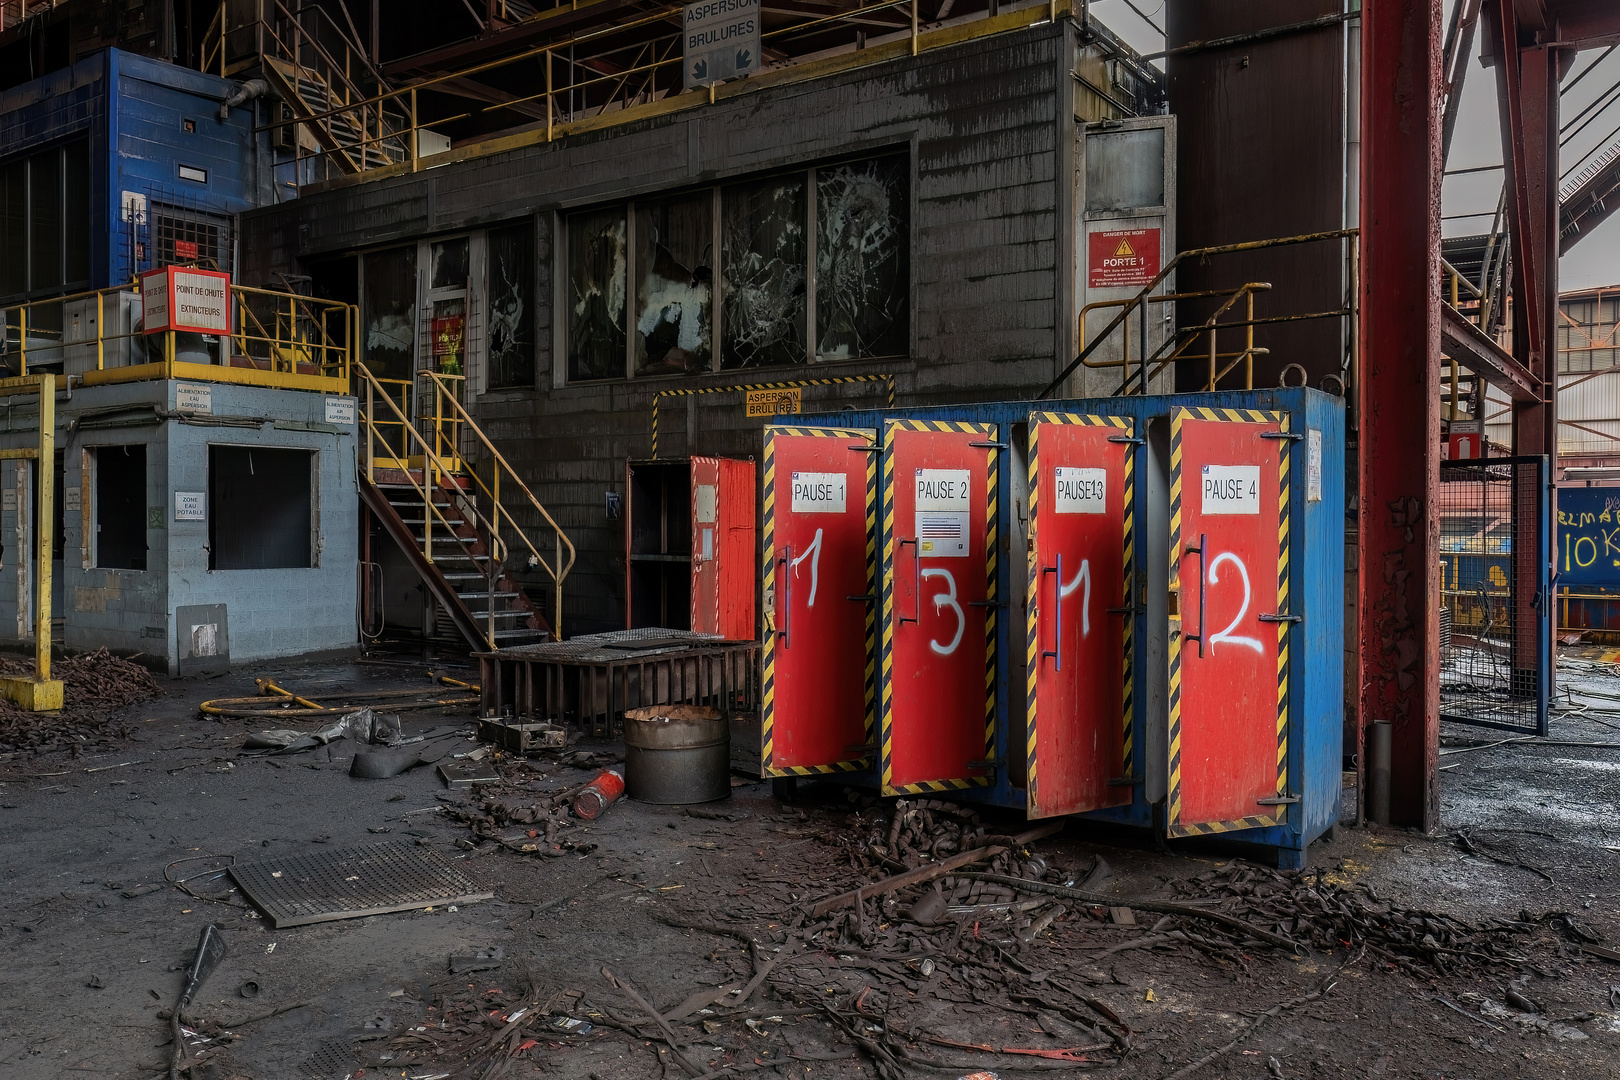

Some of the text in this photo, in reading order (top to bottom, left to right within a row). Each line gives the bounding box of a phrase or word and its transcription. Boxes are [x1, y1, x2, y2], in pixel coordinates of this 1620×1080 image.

[689, 20, 754, 48] BRULURES
[1104, 257, 1144, 267] PORTE 1
[176, 285, 224, 298] POINT DE CHUTE
[181, 304, 220, 316] EXTINCTEURS
[327, 401, 354, 409] ALIMENTATION
[794, 483, 844, 501] PAUSE 1
[918, 481, 967, 499] PAUSE 2
[1205, 479, 1256, 500] PAUSE 4
[790, 528, 823, 607] 1
[1060, 559, 1091, 639] 1
[1209, 552, 1263, 654] 2
[921, 568, 966, 655] 3
